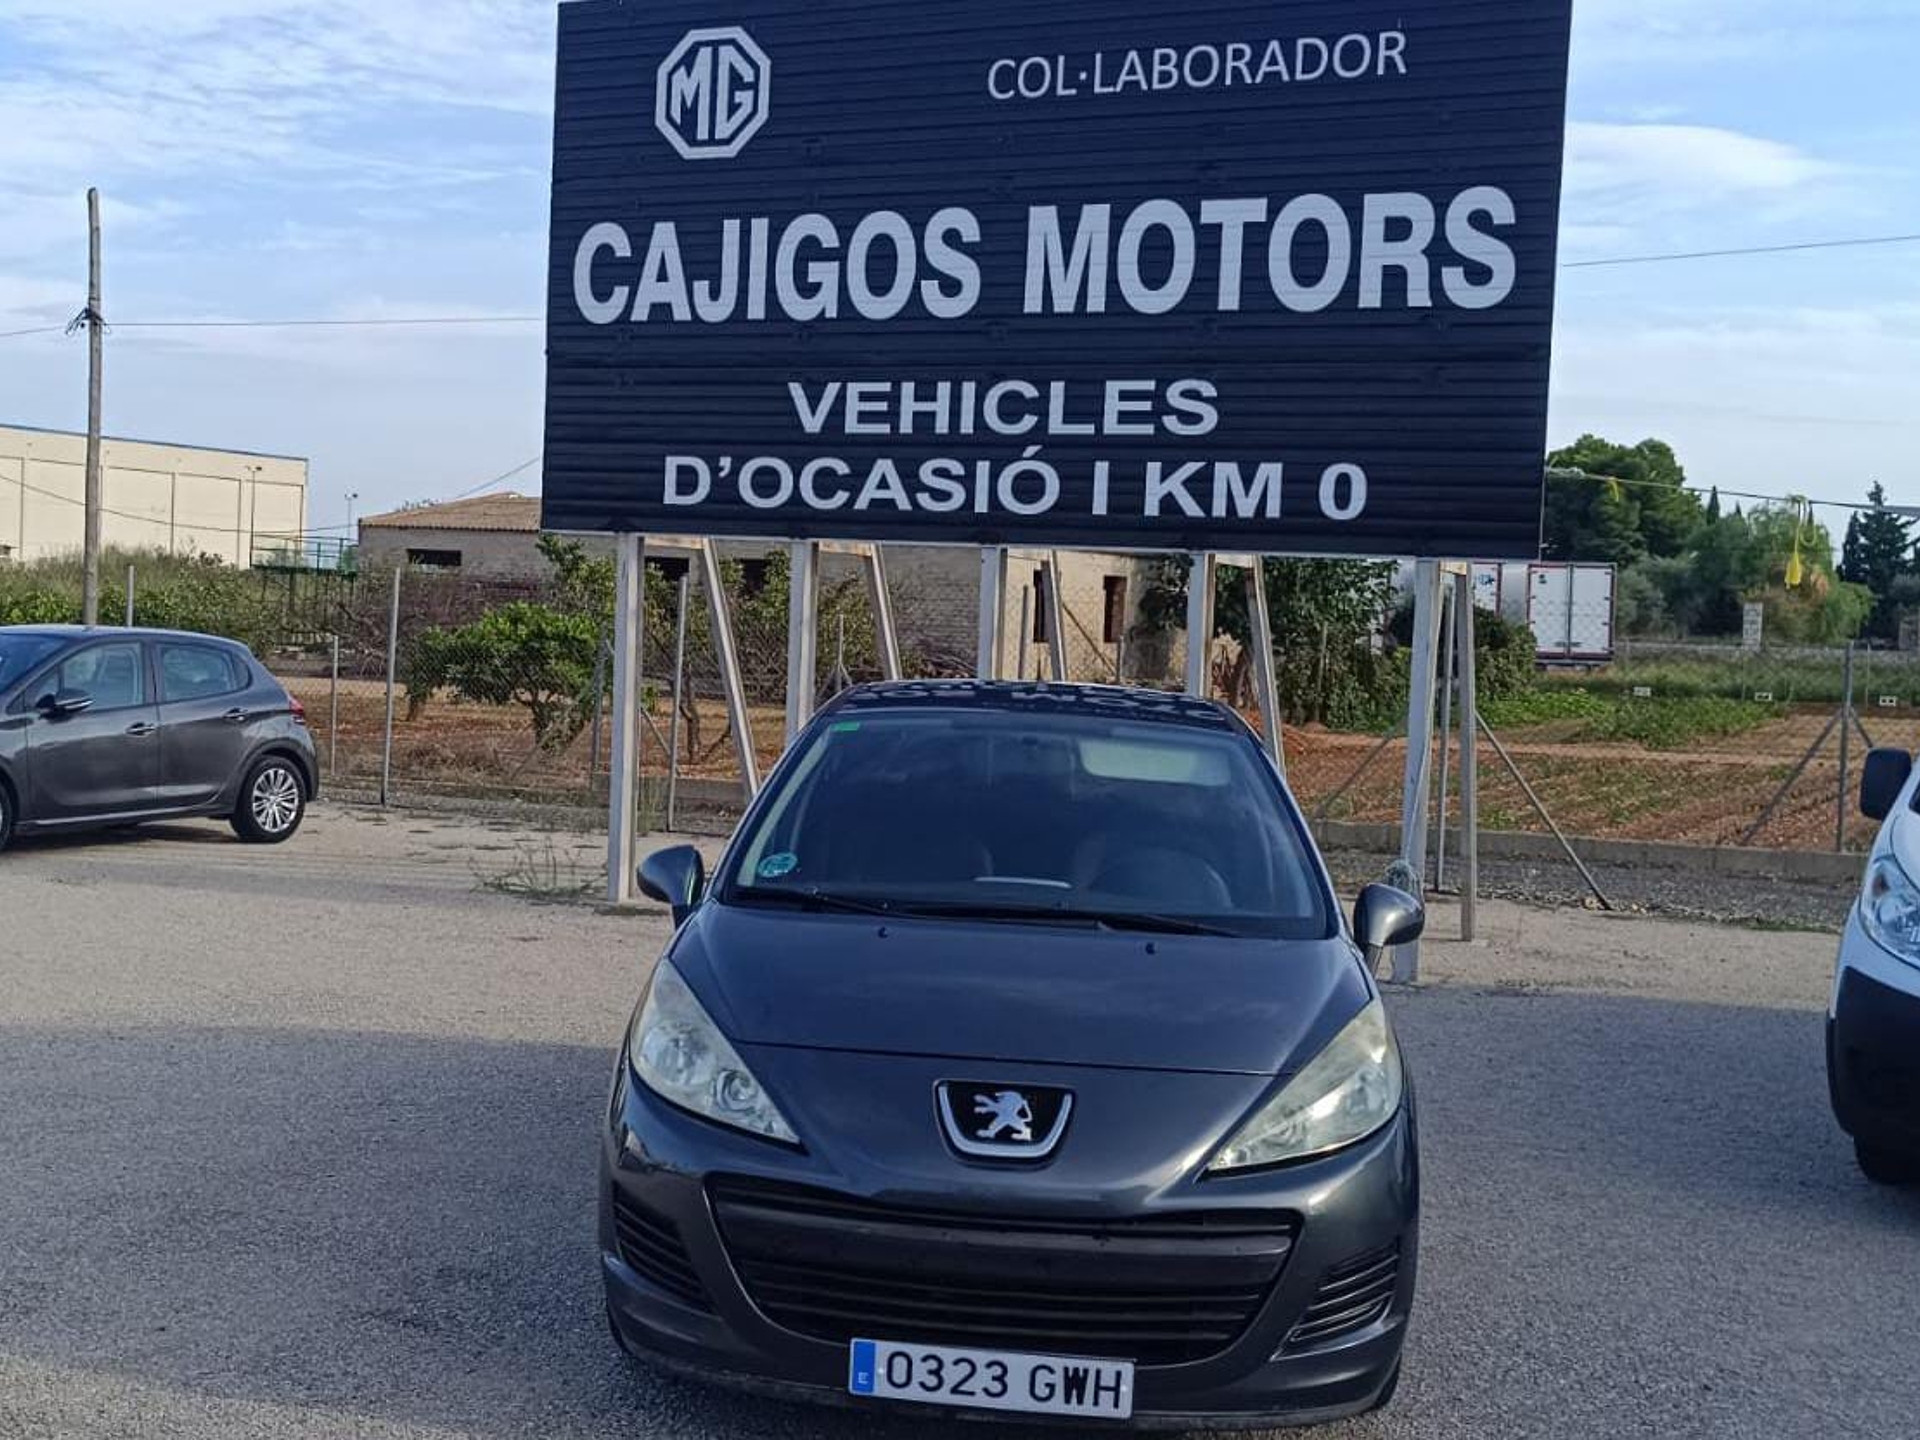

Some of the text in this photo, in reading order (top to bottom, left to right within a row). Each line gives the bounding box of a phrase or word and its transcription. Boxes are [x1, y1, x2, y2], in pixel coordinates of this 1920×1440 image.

[669, 44, 756, 141] MG
[573, 185, 1517, 325] CAJIGOS MOTORS
[787, 379, 1219, 436] VEHICLES
[1091, 460, 1110, 516] I
[1143, 461, 1283, 519] KM
[1318, 462, 1367, 521] 0
[886, 1350, 1123, 1410] 0323 GWH
